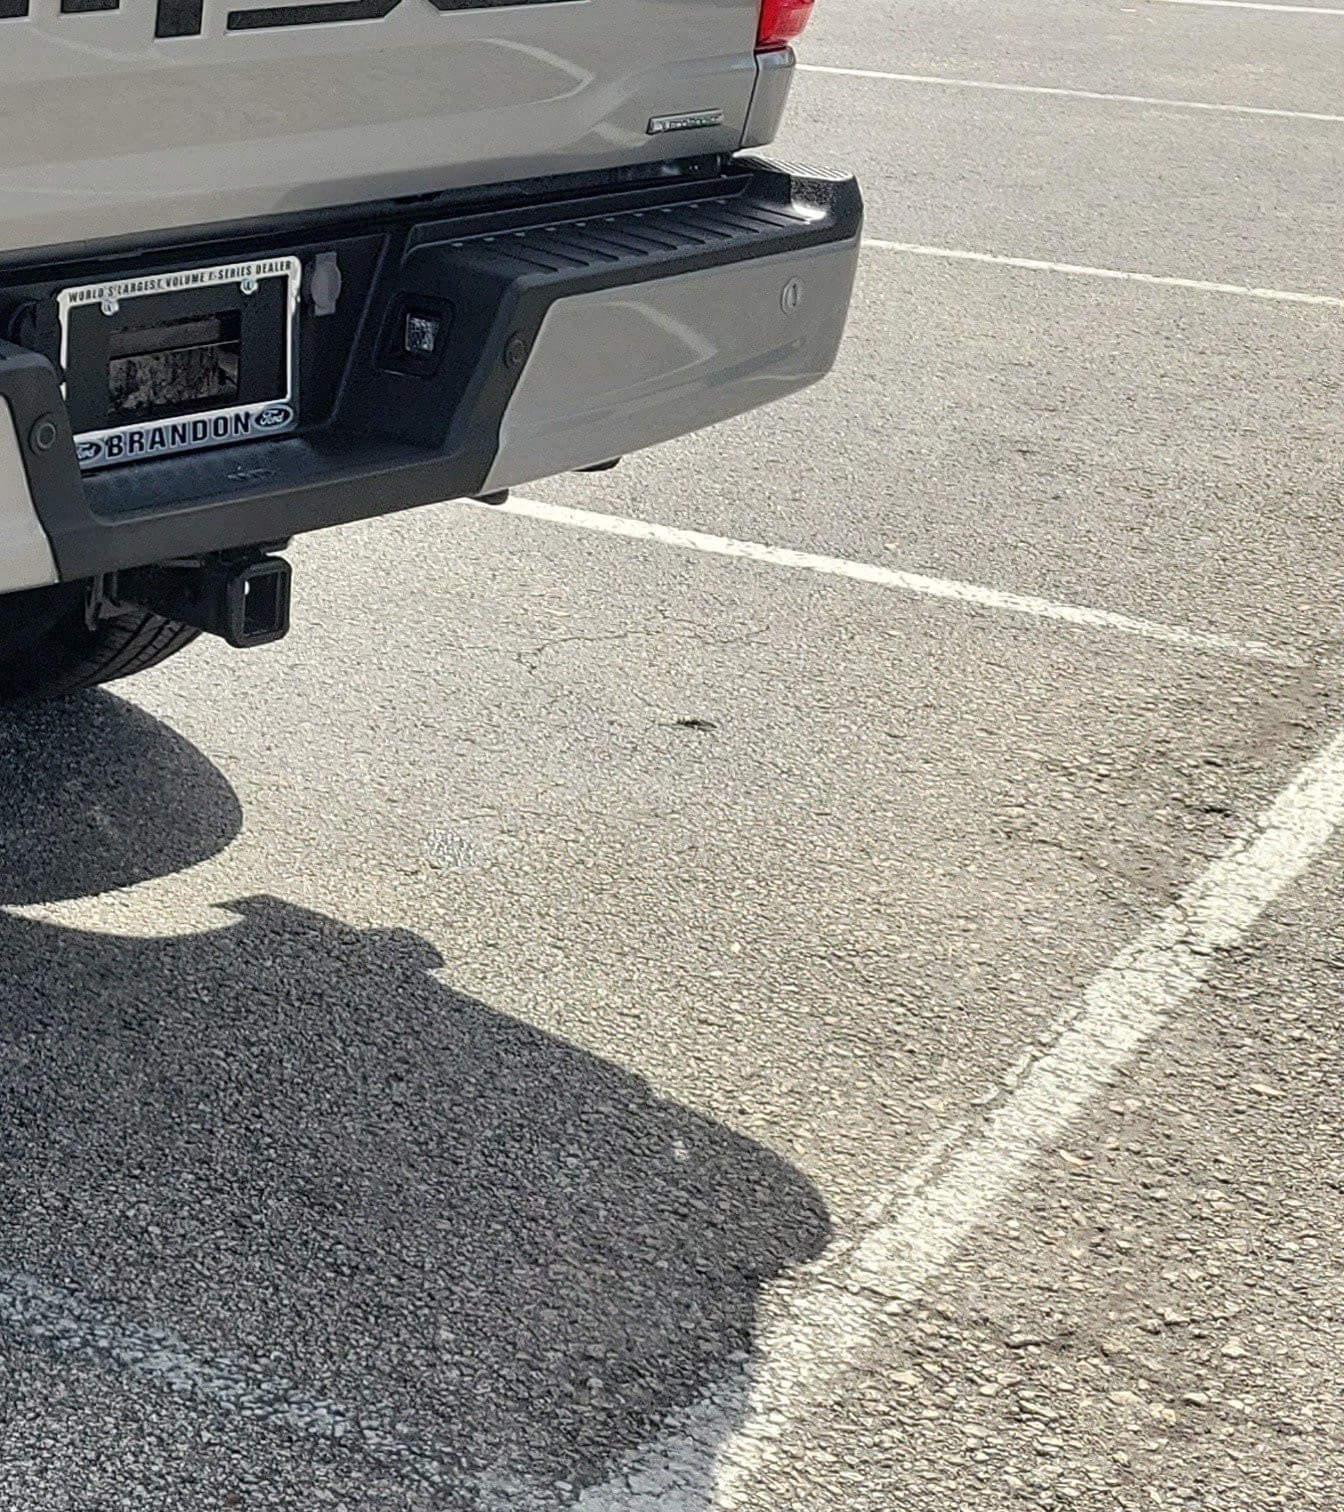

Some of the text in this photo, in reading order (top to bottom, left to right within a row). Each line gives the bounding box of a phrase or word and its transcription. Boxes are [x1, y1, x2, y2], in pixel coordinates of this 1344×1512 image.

[117, 278, 162, 295] LARGEST
[165, 272, 204, 287] VOLUME
[208, 265, 252, 280] F-SERIES
[255, 260, 292, 275] DEALER
[106, 412, 250, 458] BRANDON
[260, 407, 285, 426] Ford
